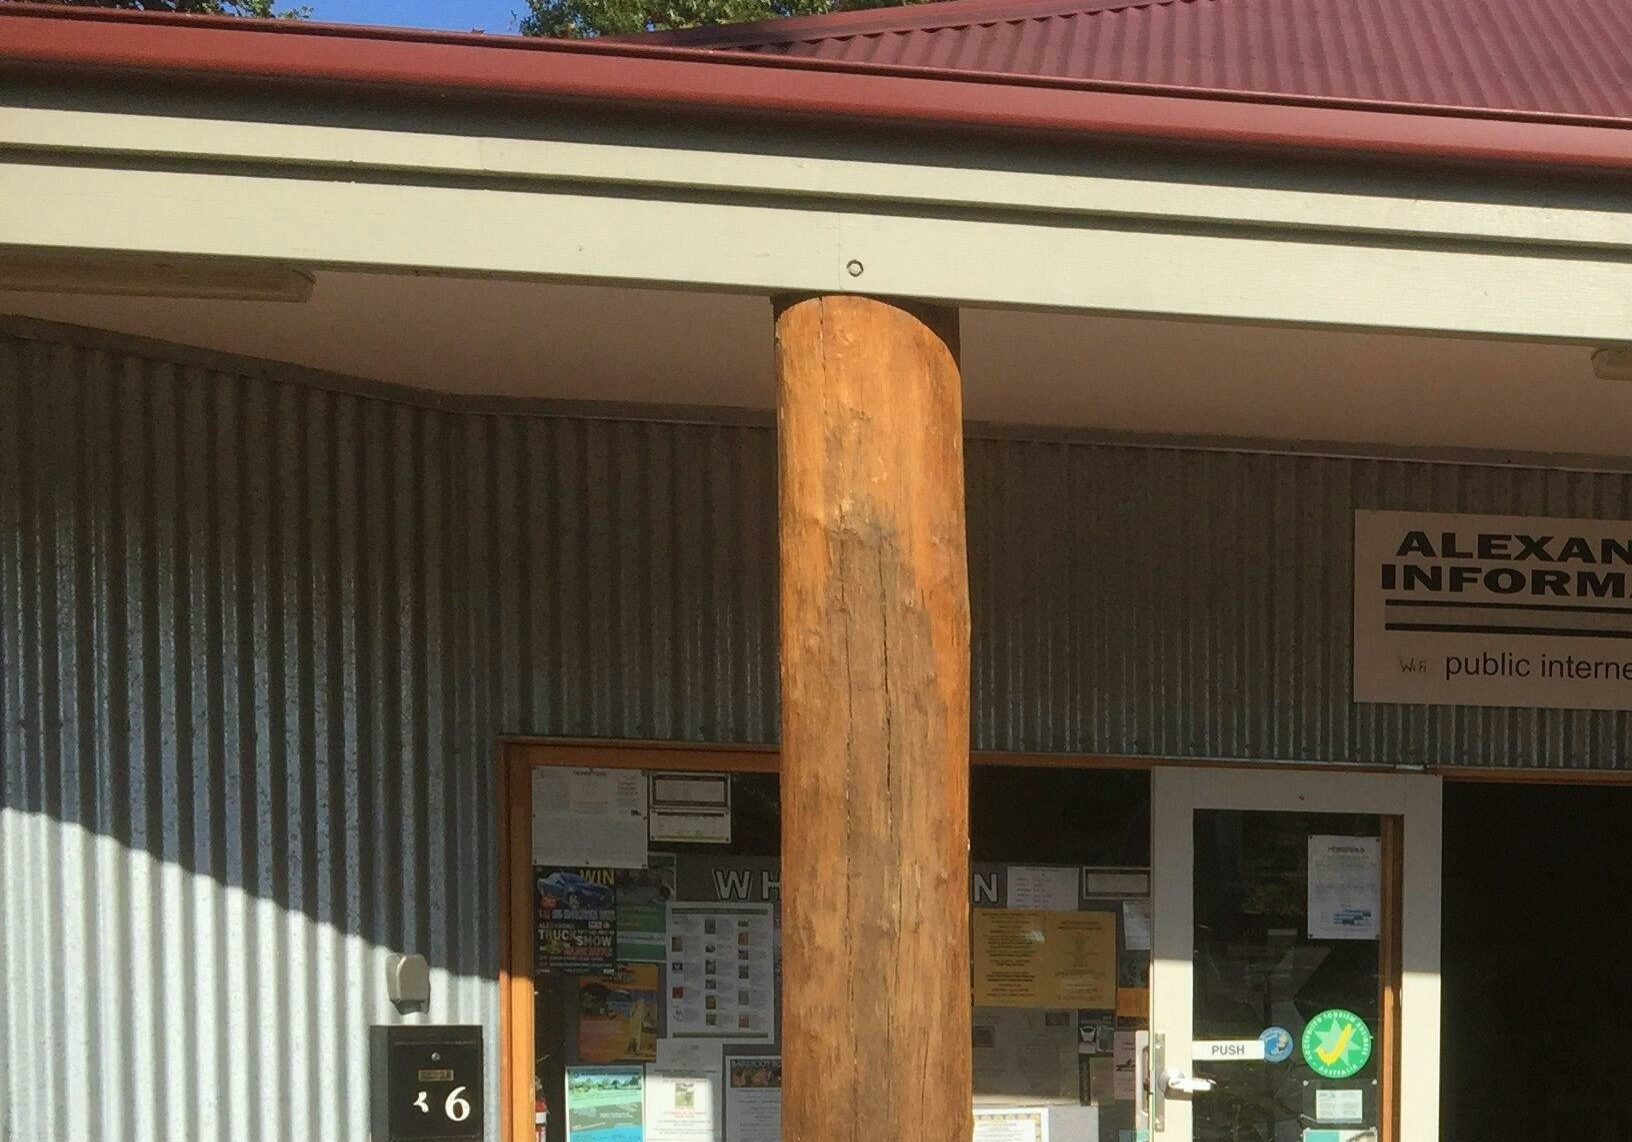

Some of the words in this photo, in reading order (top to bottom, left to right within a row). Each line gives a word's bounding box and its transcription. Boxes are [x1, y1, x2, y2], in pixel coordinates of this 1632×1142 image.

[1446, 652, 1530, 680] public
[580, 869, 615, 885] WIN
[1211, 1045, 1245, 1056] PUSH
